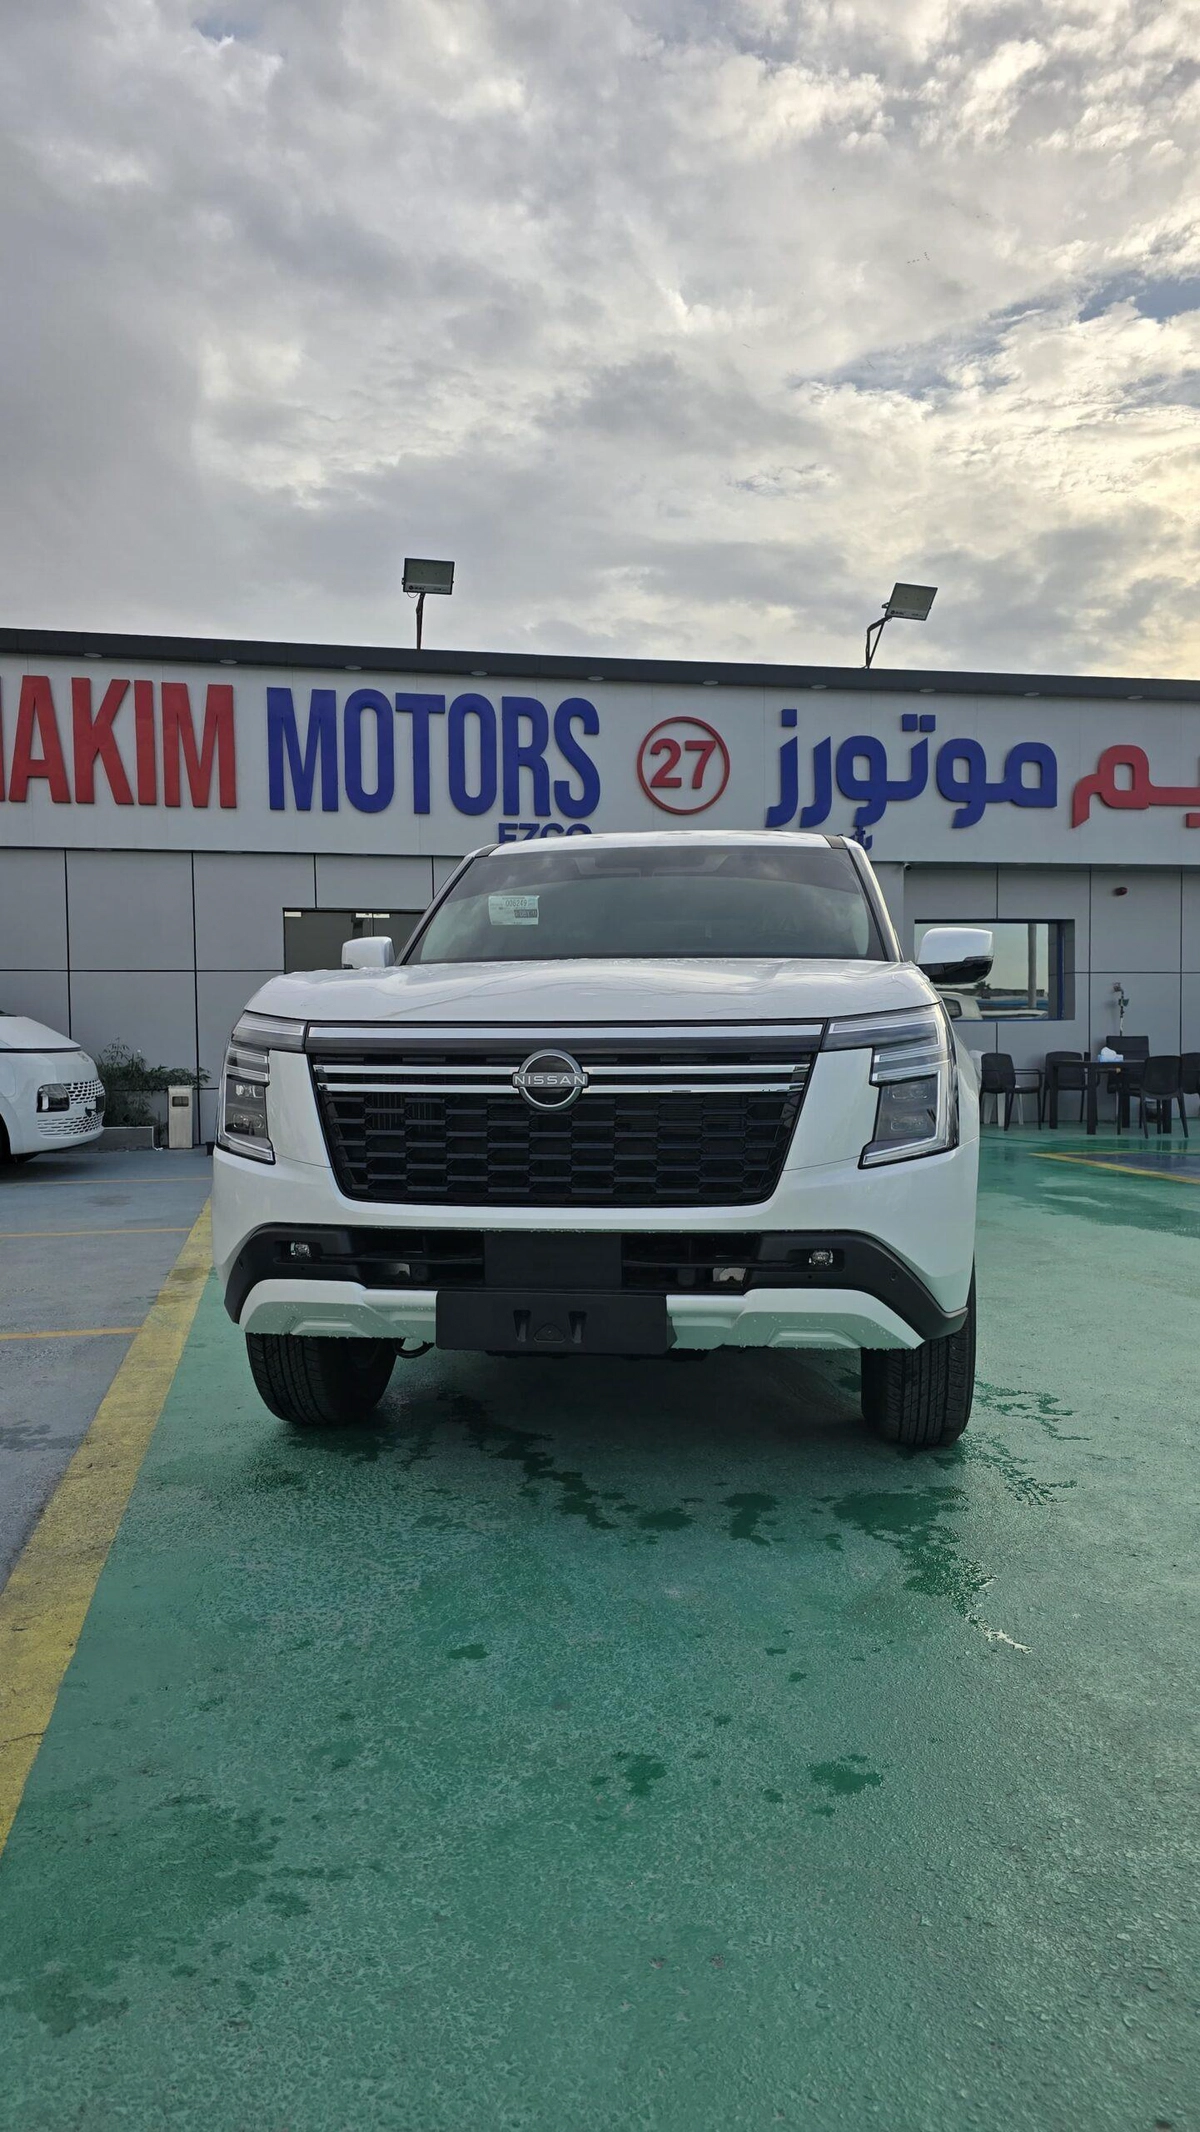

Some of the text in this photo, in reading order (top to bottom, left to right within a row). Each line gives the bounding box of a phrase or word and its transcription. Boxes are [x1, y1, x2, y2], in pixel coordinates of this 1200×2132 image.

[0, 673, 600, 819] AKIM MOTORS
[650, 738, 717, 789] 27
[766, 708, 1058, 828] موتورز
[514, 1075, 586, 1085] NISSAN
